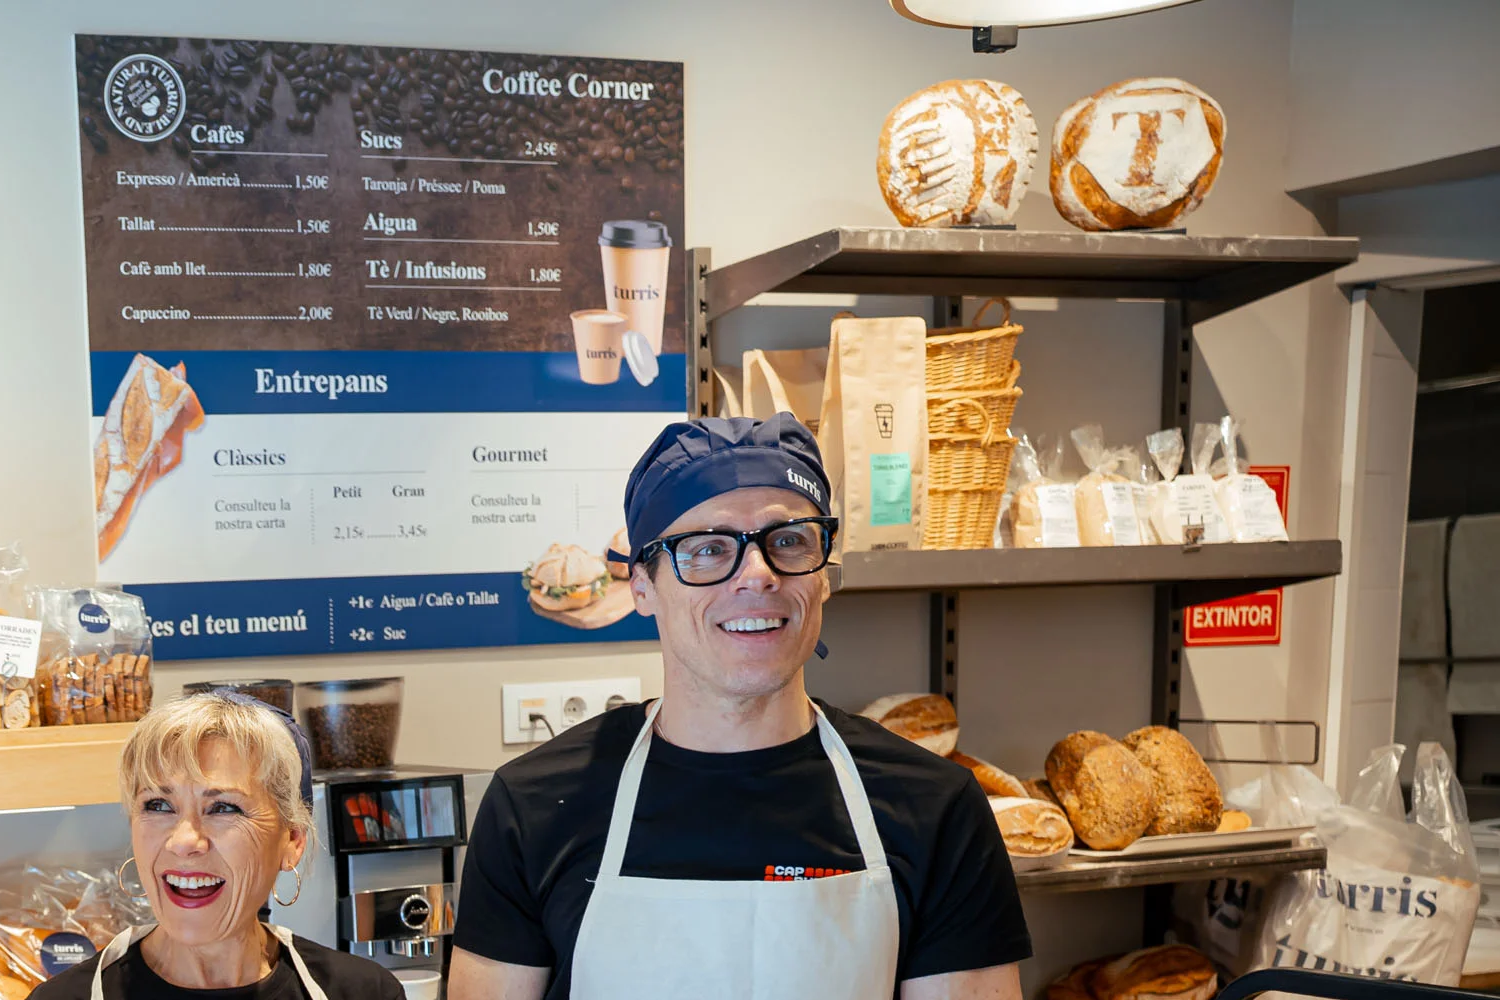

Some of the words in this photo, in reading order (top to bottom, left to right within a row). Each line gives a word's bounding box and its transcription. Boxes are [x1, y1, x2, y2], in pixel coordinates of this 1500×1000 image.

[112, 61, 150, 118] NATURAL
[151, 63, 179, 116] TURRIS
[482, 68, 562, 97] Coffee
[568, 72, 654, 101] Corner
[124, 113, 172, 134] BLEND
[190, 124, 245, 145] Cafès
[360, 130, 402, 149] Sucs
[524, 142, 558, 157] 2,45€
[116, 171, 176, 188] Expresso
[186, 172, 240, 187] Americà
[295, 175, 329, 190] 1,50€
[362, 176, 407, 194] Taronja
[418, 178, 462, 193] Préssec
[472, 180, 506, 195] Poma
[117, 216, 156, 231] Tallat
[296, 219, 330, 234] 1,50€
[363, 212, 417, 235] Aigua
[528, 222, 560, 236] 1,50€
[119, 261, 151, 276] Cafè
[154, 262, 182, 275] amb
[185, 262, 206, 275] llet
[298, 263, 332, 278] 1,80€
[366, 260, 390, 279] Tè
[405, 260, 487, 280] Infusions
[530, 268, 562, 283] 1,80€
[614, 284, 659, 300] turris
[121, 306, 191, 323] Capuccino
[298, 306, 333, 322] 2,00€
[367, 306, 384, 320] Tè
[385, 306, 413, 321] Verd
[422, 307, 460, 324] Negre,
[462, 306, 509, 322] Rooibos
[586, 347, 617, 359] turris
[255, 368, 388, 400] Entrepans
[213, 448, 286, 467] Clàssics
[472, 446, 548, 463] Gourmet
[333, 485, 362, 498] Petit
[392, 485, 425, 498] Gran
[786, 468, 821, 502] turris
[214, 498, 276, 513] Consulteu
[280, 498, 291, 511] la
[471, 494, 528, 507] Consulteu
[531, 494, 541, 506] la
[215, 518, 253, 531] nostra
[256, 516, 286, 530] carta
[472, 512, 506, 524] nostra
[509, 512, 536, 523] carta
[333, 526, 365, 541] 2,15€
[348, 595, 374, 609] +1€
[380, 594, 416, 611] Aigua
[426, 592, 454, 607] Cafè
[456, 595, 465, 606] o
[466, 591, 499, 606] Tallat
[80, 612, 109, 625] turris
[180, 613, 200, 636] el
[205, 615, 241, 635] teu
[246, 609, 308, 633] menú
[1193, 605, 1272, 628] EXTINTOR
[349, 627, 375, 642] +2€
[383, 626, 407, 640] Suc
[774, 865, 805, 877] CAP
[53, 943, 84, 953] turris
